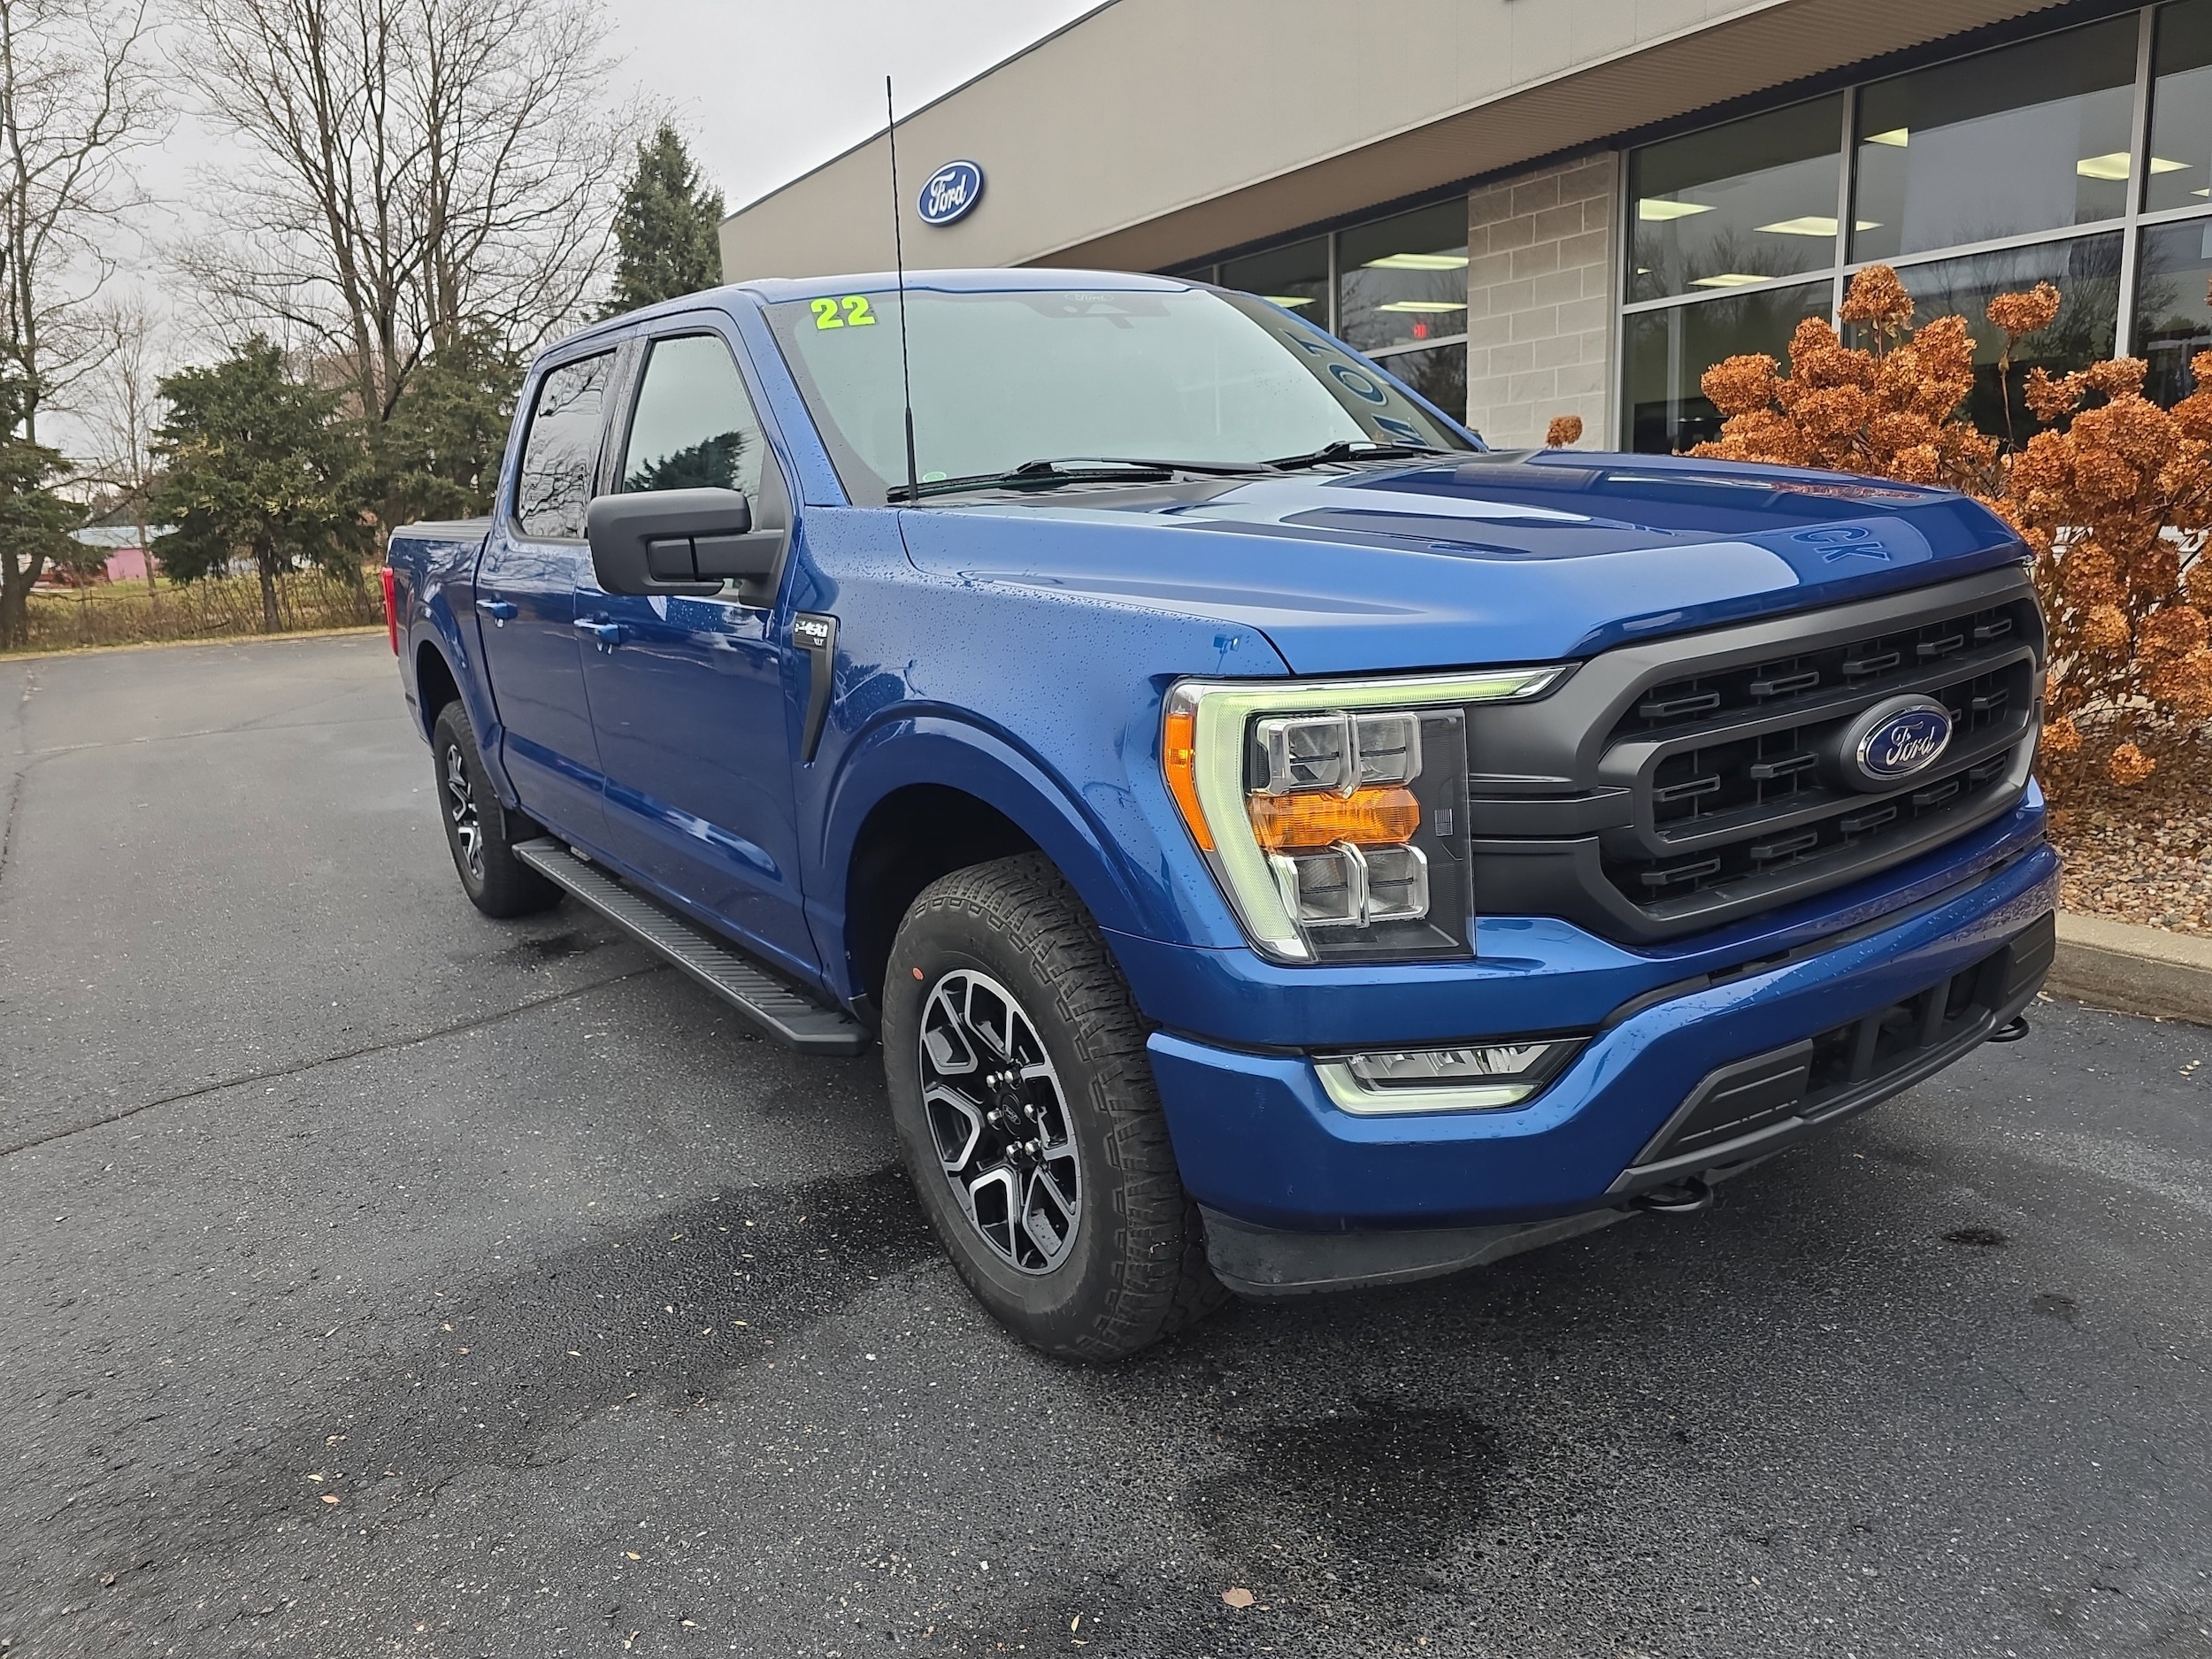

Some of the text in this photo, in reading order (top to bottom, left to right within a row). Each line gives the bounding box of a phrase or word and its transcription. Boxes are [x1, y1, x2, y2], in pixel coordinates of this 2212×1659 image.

[928, 170, 969, 218] Ford
[810, 296, 876, 330] 22
[1886, 721, 1939, 765] Ford
